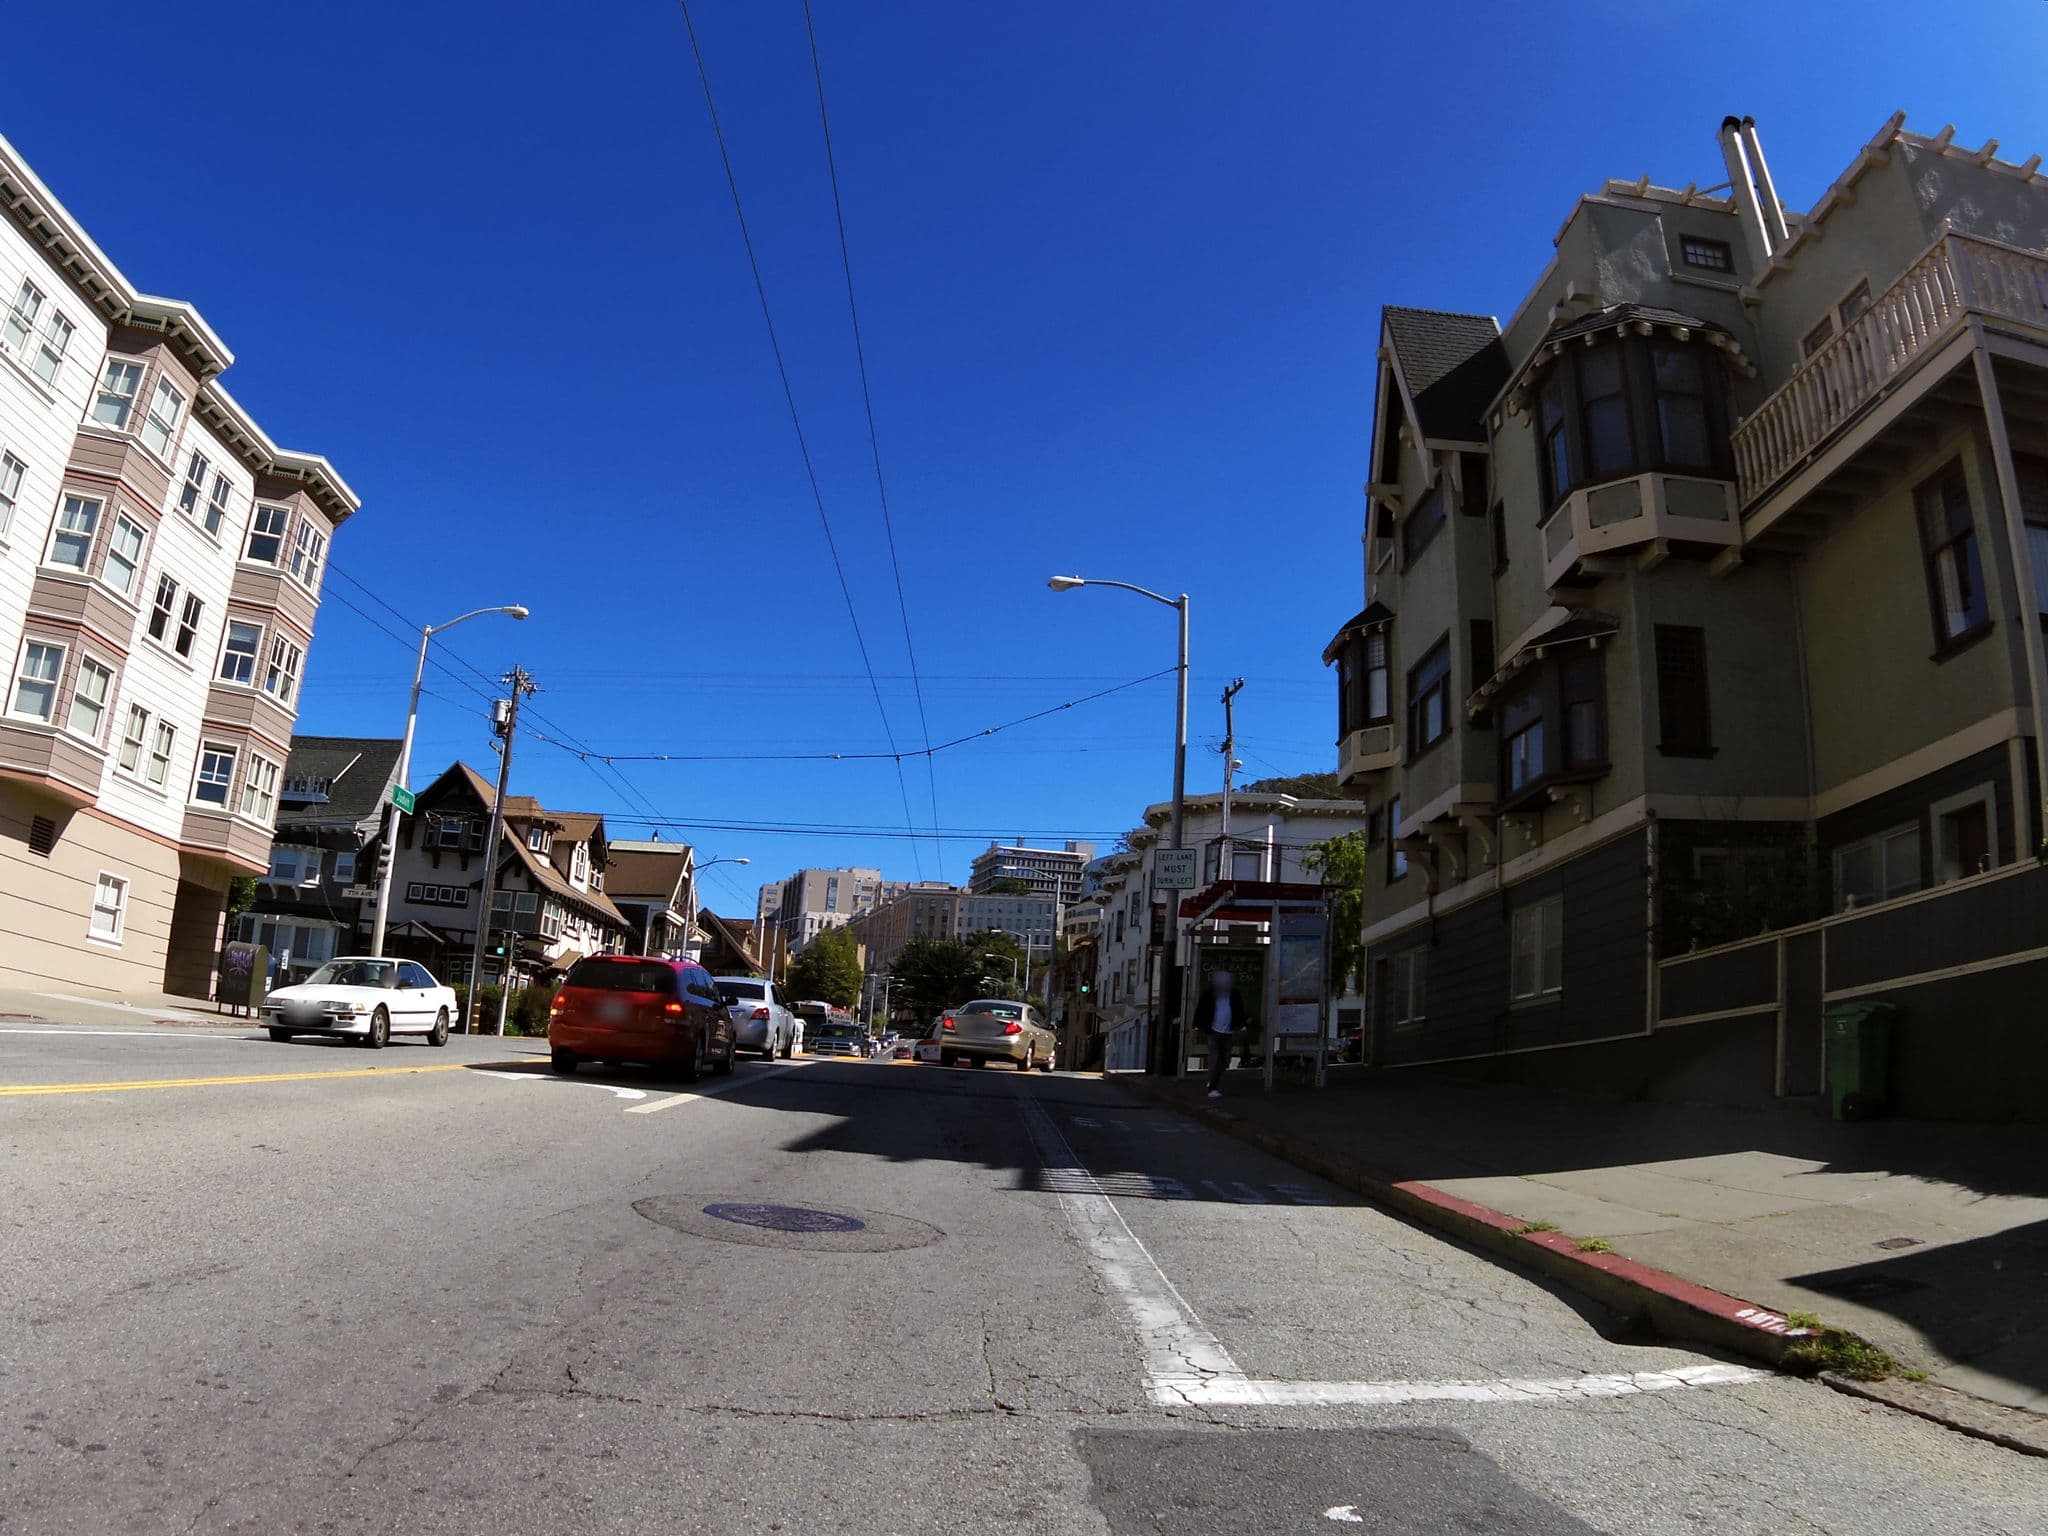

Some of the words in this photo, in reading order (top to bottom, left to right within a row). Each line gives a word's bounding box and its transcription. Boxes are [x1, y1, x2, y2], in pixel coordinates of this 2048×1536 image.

[1158, 853, 1174, 861] LEFT
[1176, 853, 1193, 861] LANE
[1163, 864, 1186, 873] MUST
